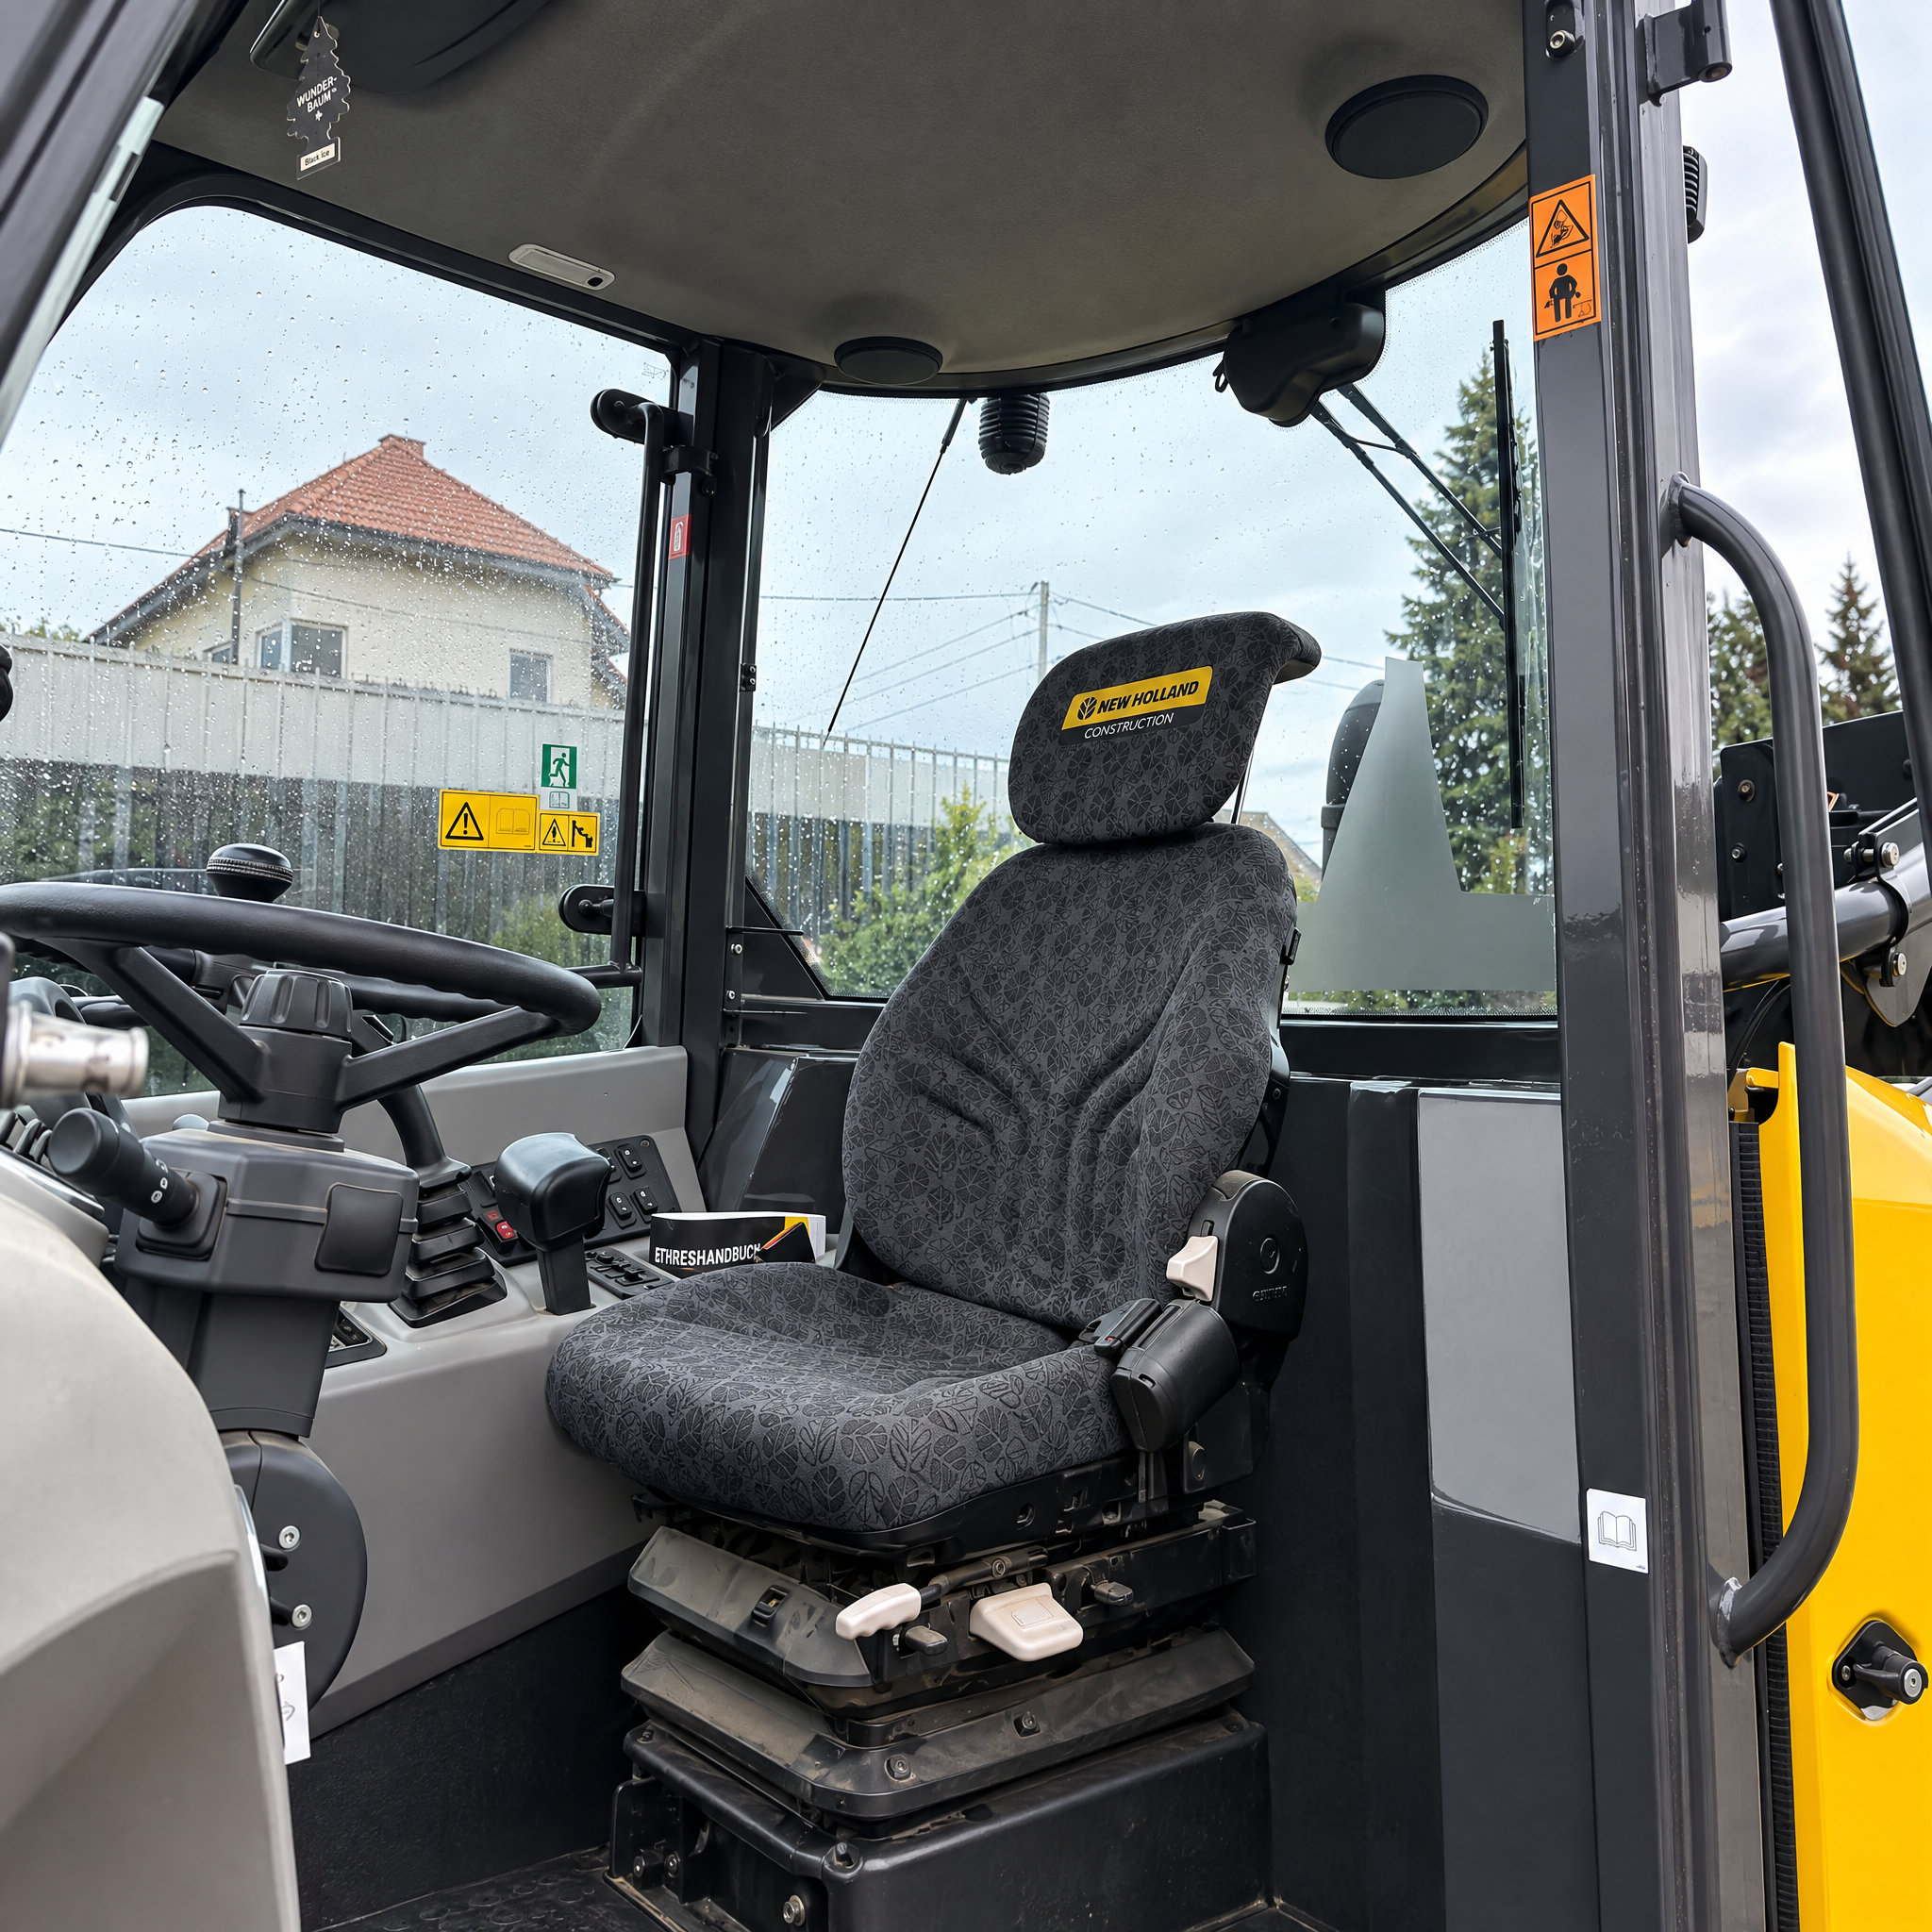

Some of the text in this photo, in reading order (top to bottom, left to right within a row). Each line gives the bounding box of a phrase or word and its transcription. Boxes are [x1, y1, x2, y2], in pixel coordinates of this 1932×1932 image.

[297, 76, 338, 107] WUNDER-
[1097, 680, 1200, 714] NEW HOLLAND
[1084, 712, 1174, 740] CONSTRUCTION
